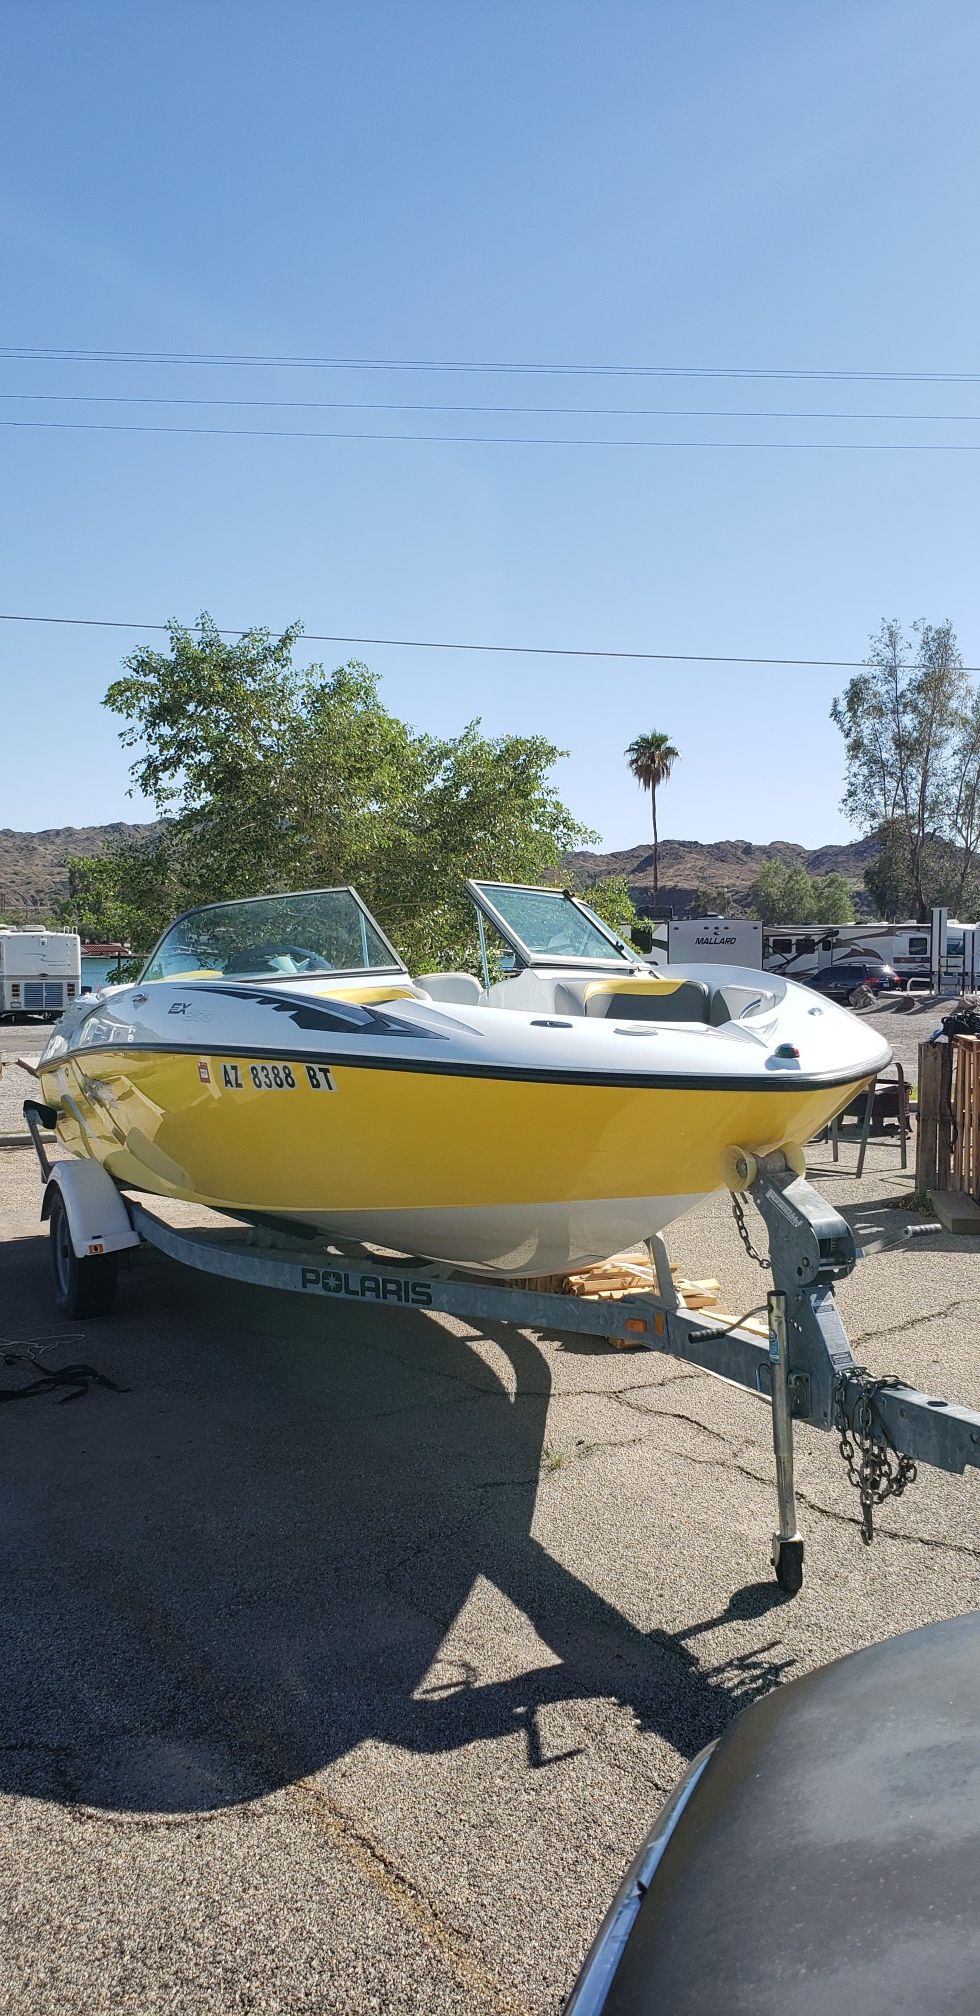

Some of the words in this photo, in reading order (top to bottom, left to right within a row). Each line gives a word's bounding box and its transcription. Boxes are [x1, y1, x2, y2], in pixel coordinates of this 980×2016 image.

[695, 937, 737, 945] MALLARD
[168, 1002, 193, 1015] EX
[223, 1064, 243, 1088] AZ
[250, 1065, 296, 1089] 8388
[305, 1065, 333, 1091] BT
[301, 1267, 433, 1306] POLARIS
